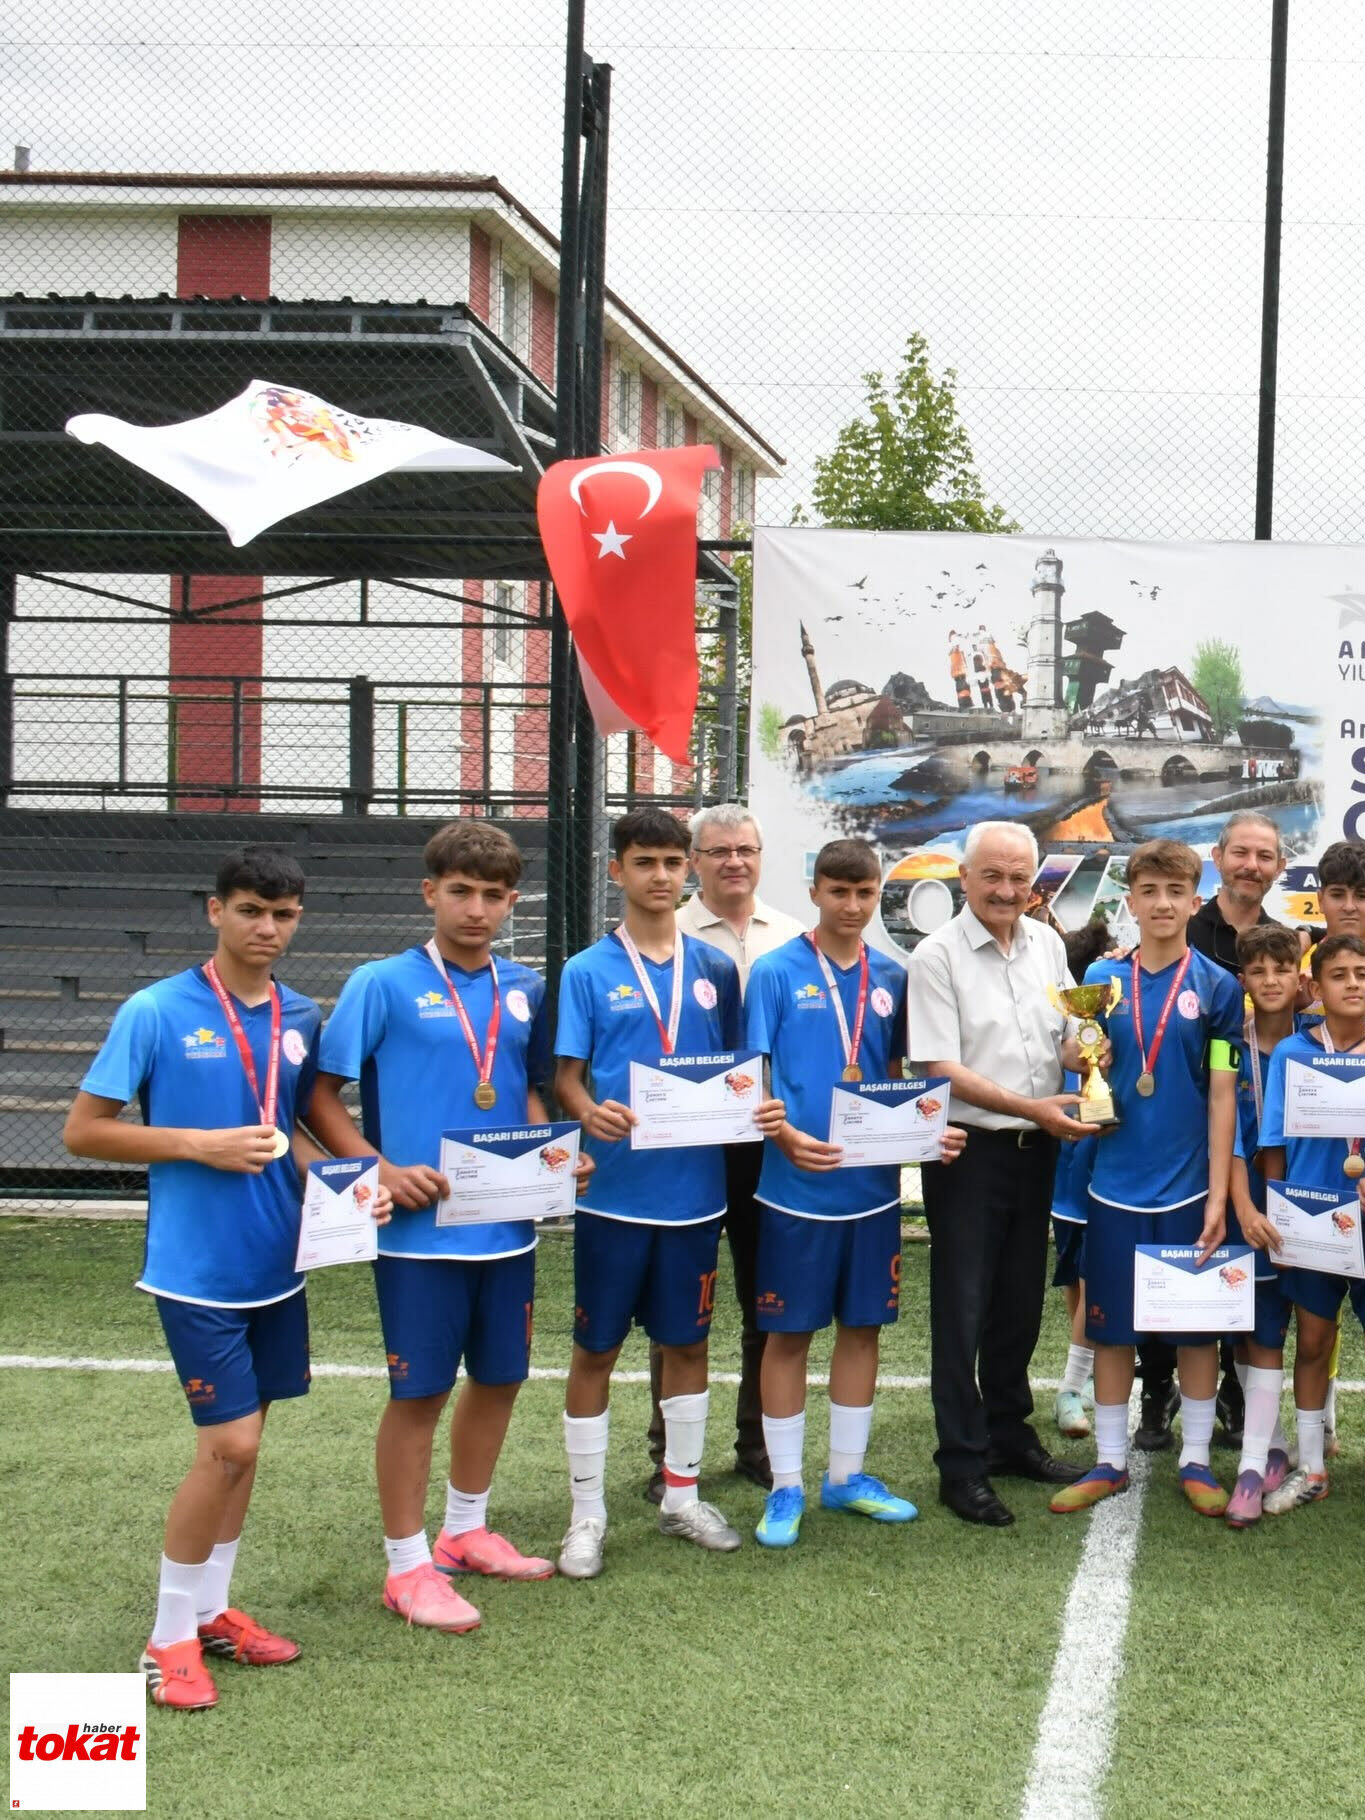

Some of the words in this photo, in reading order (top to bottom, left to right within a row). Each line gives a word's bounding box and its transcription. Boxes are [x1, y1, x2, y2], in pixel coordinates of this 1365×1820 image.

[660, 1057, 695, 1067] BAŞARI
[1312, 1057, 1344, 1066] BAŞARI
[859, 1083, 891, 1093] BAŞARI
[473, 1132, 510, 1143] BAŞARI
[1161, 1250, 1193, 1259] BAŞARI
